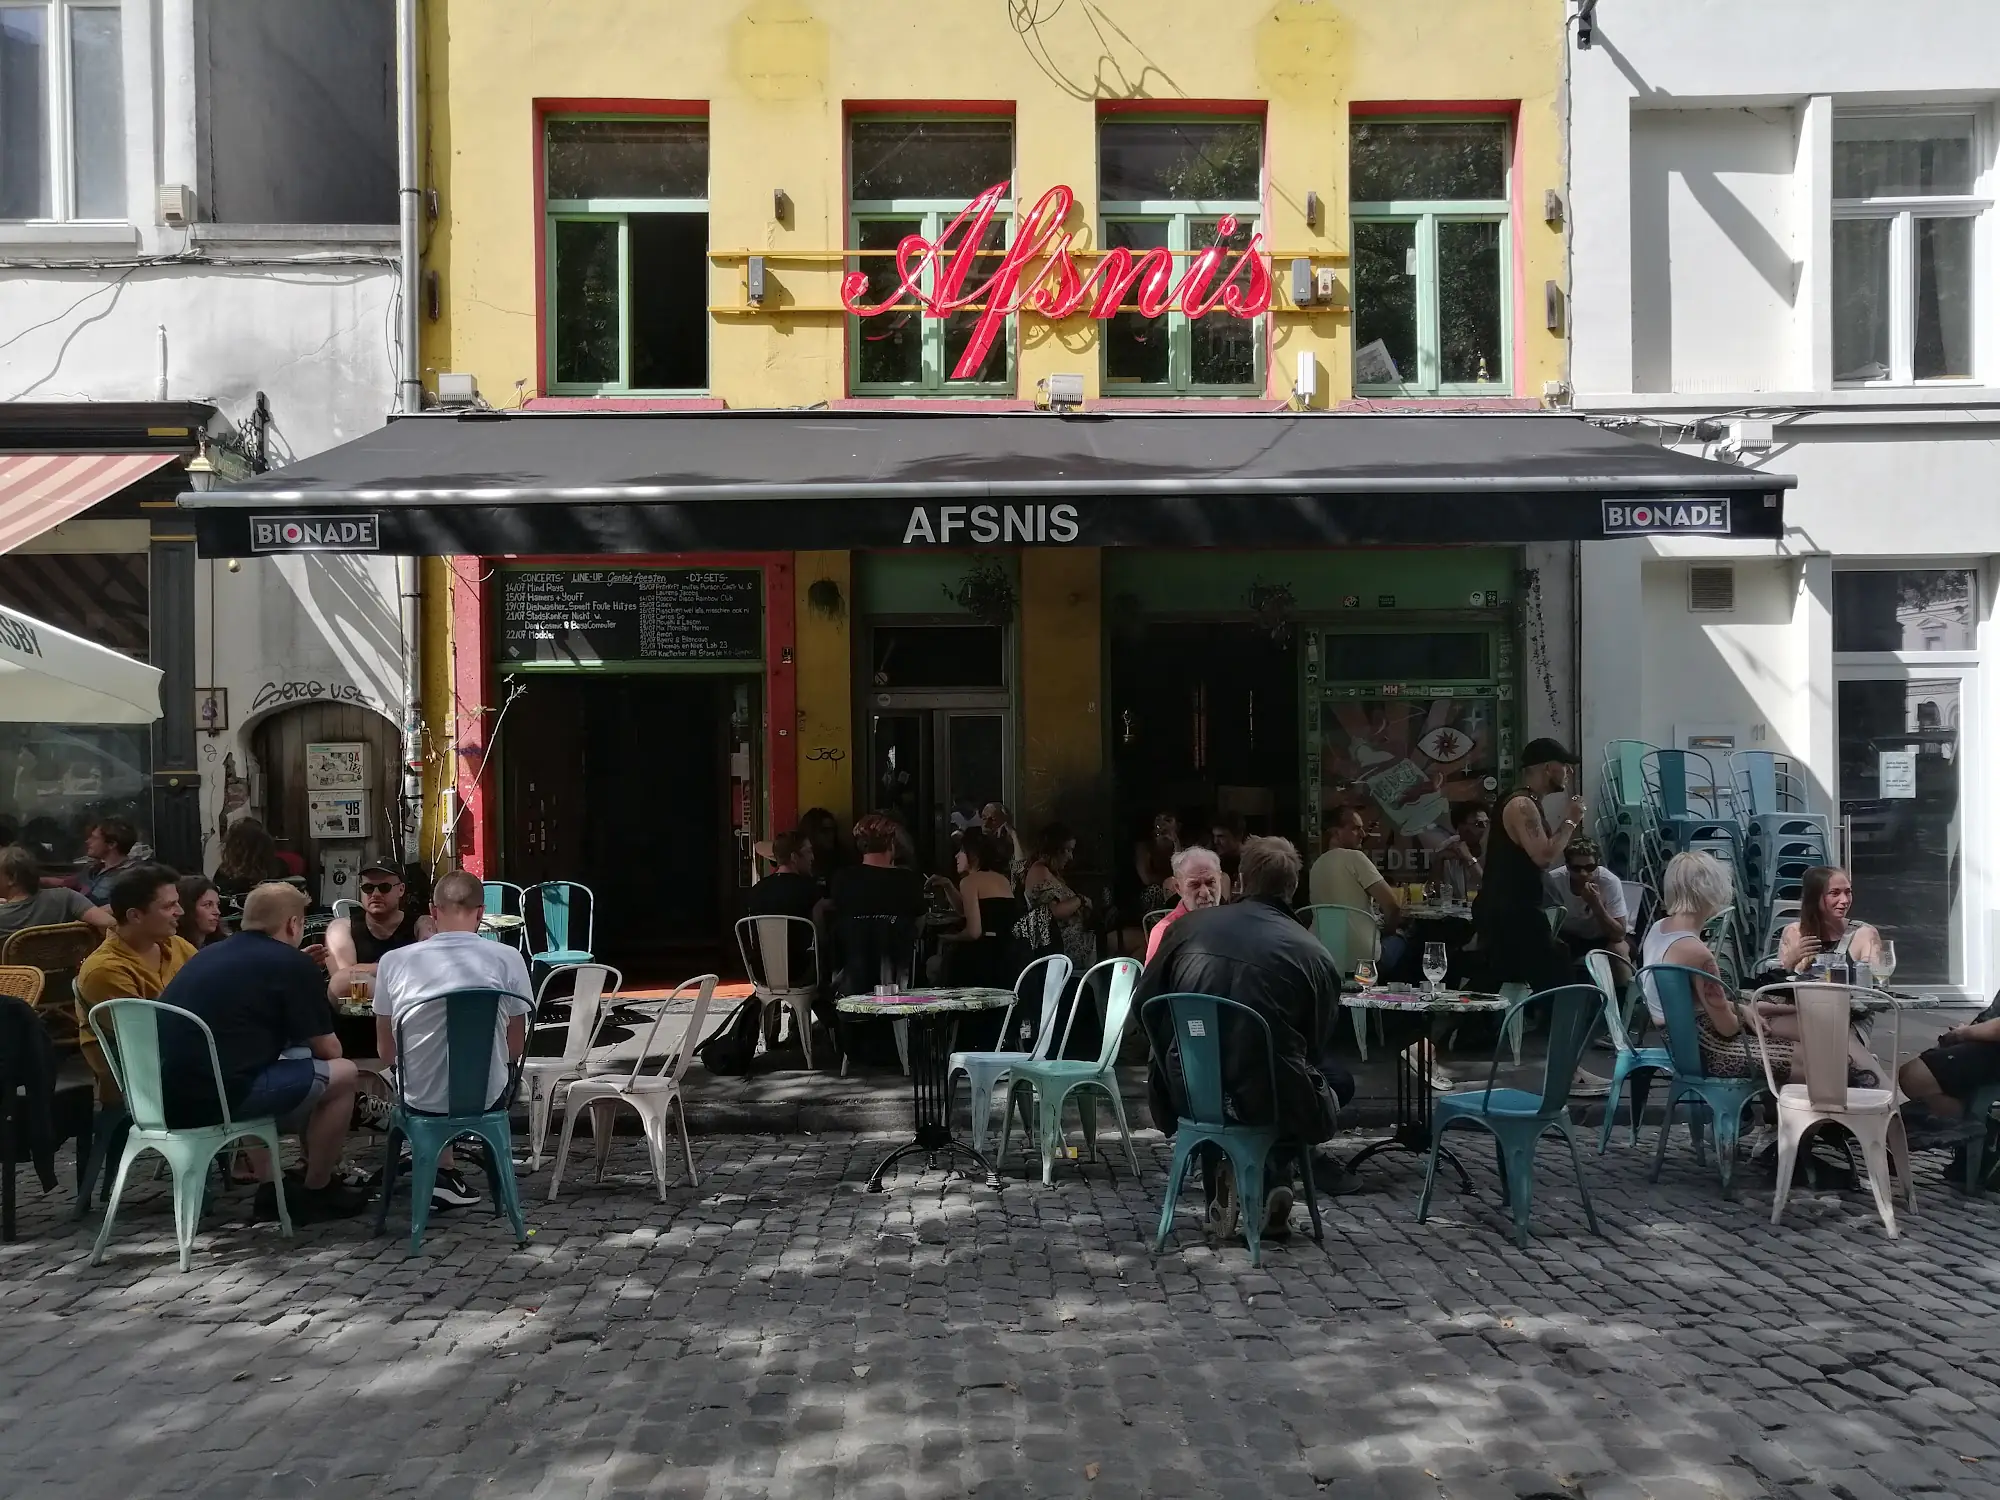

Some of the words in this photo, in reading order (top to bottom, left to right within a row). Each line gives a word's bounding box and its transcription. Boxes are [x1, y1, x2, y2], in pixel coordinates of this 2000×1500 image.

[841, 180, 1272, 379] Afsnis
[1608, 504, 1724, 527] BIONADE
[902, 504, 1080, 544] AFSNIS
[257, 522, 372, 544] BIONADE
[572, 572, 604, 583] LINE-UP
[505, 583, 525, 593] 14/07
[527, 583, 544, 592] Mind
[546, 584, 564, 593] Rays
[505, 592, 526, 602] 15/07
[720, 594, 734, 602] Club
[505, 602, 526, 611] 19/07
[592, 601, 612, 611] Foute
[683, 606, 694, 614] wel
[505, 611, 526, 621] 21/07
[571, 611, 590, 621] Night
[0, 614, 43, 659] SBY
[506, 630, 527, 640] 22/07
[528, 630, 555, 640] Modder
[640, 642, 657, 650] 22/07
[657, 642, 681, 650] Thomas
[705, 641, 718, 649] Lab
[719, 640, 728, 649] 23
[640, 649, 657, 657] 23/07
[697, 648, 716, 657] Stars
[1751, 724, 1766, 741] 11
[348, 752, 360, 762] 9A
[345, 801, 360, 816] 9B
[1367, 848, 1435, 871] EDET
